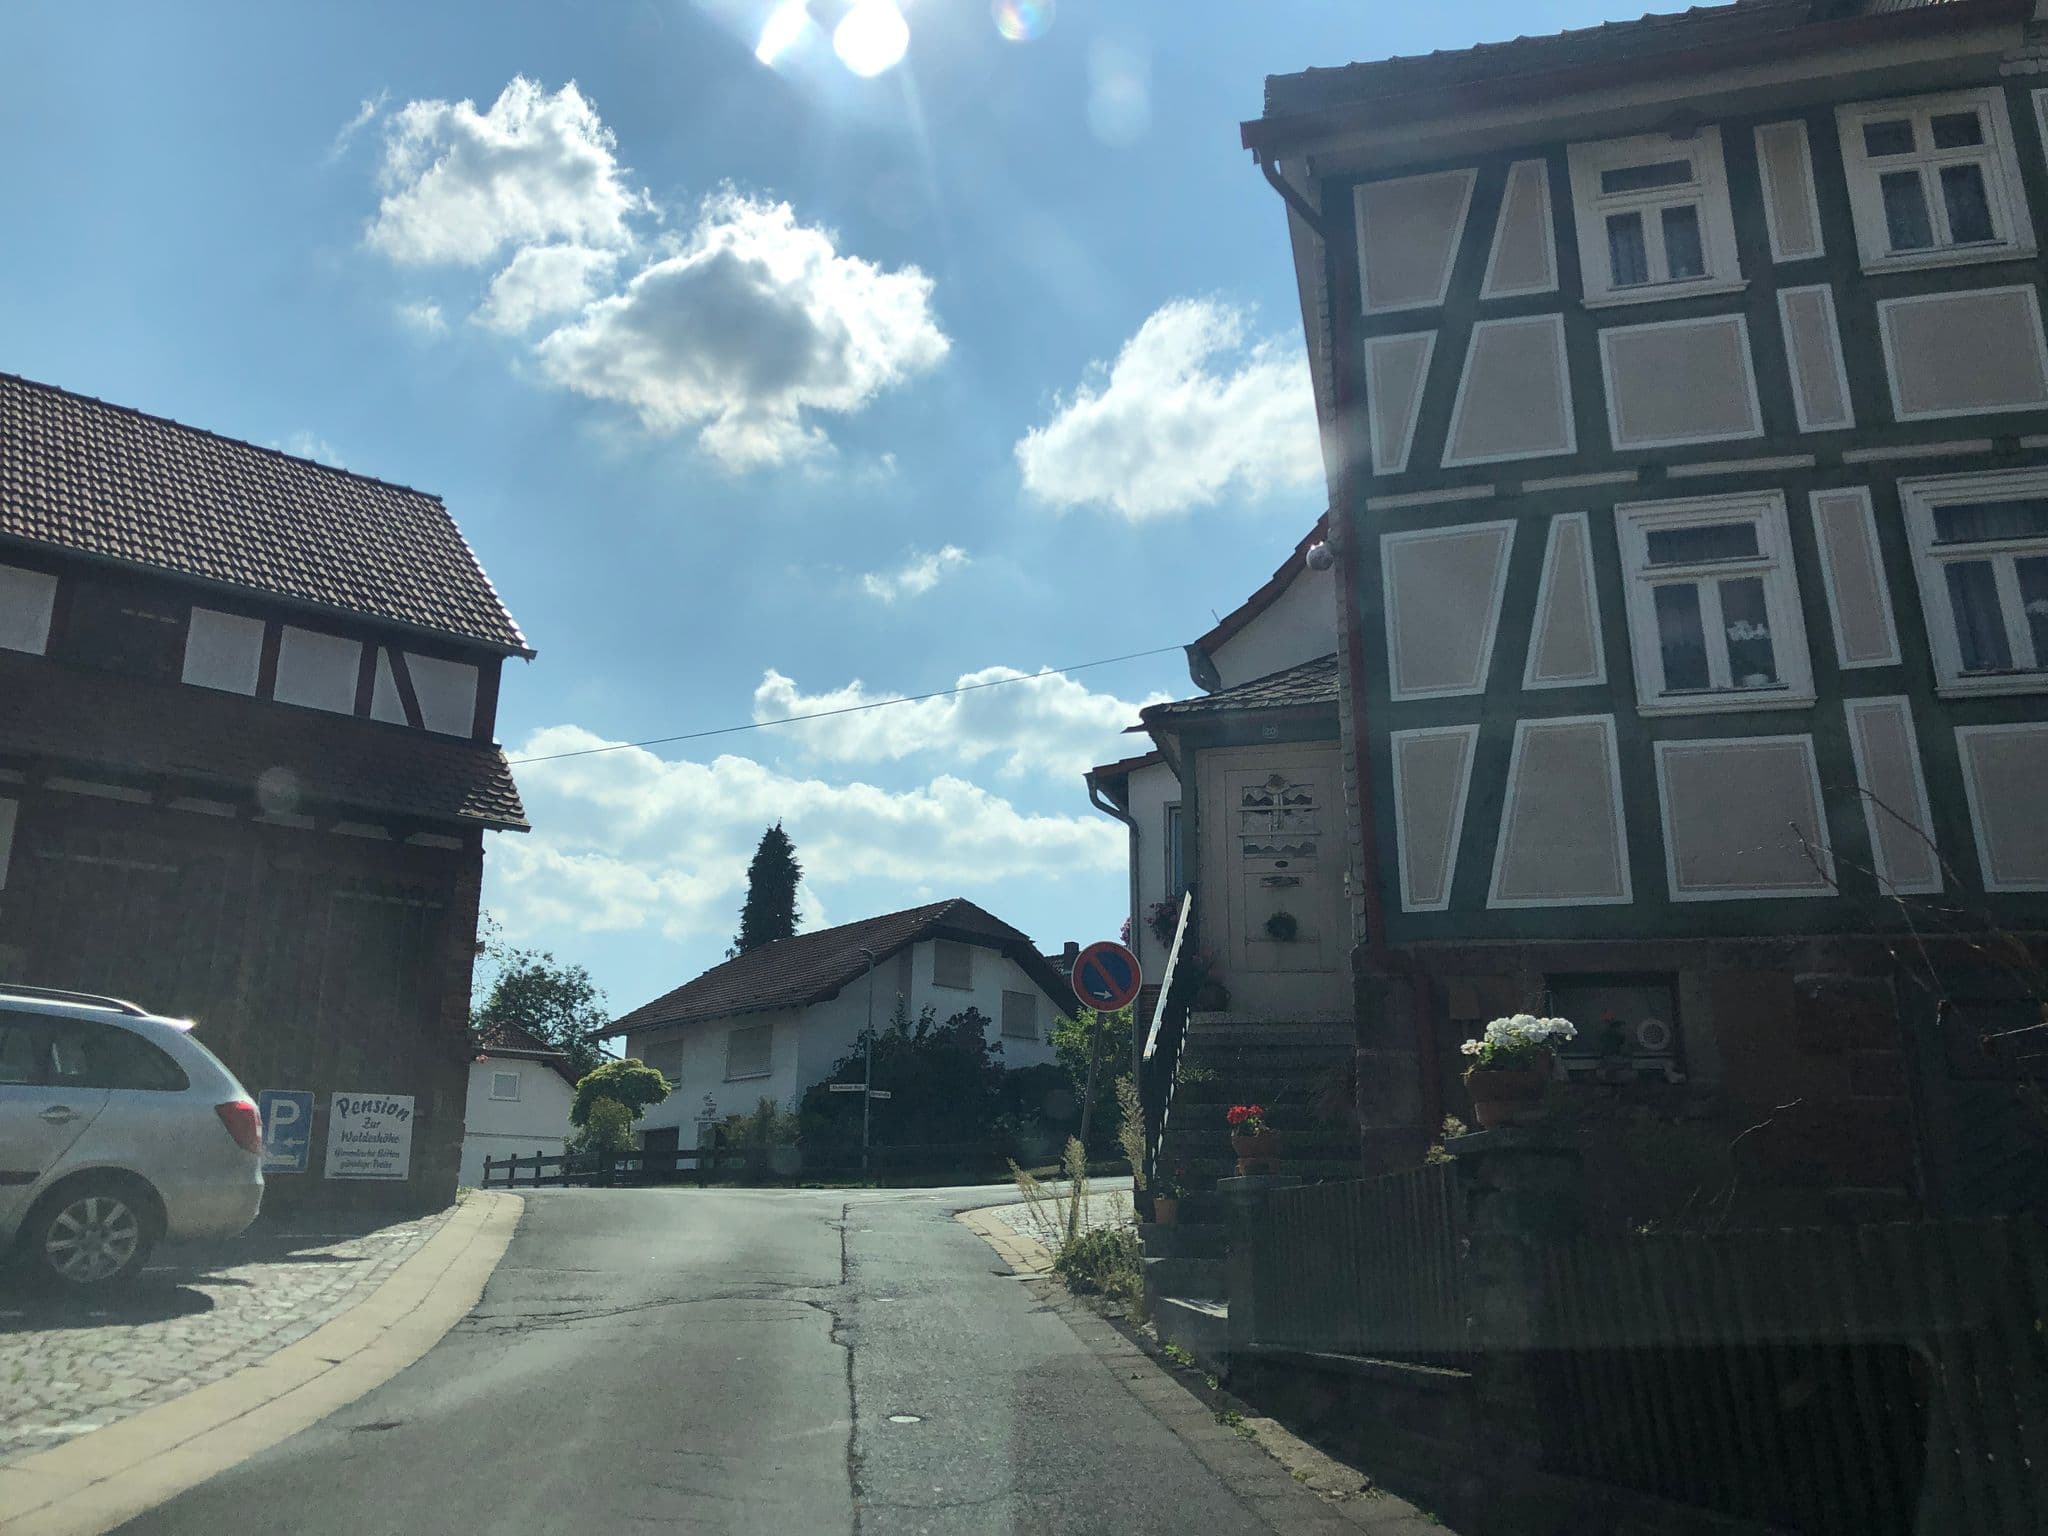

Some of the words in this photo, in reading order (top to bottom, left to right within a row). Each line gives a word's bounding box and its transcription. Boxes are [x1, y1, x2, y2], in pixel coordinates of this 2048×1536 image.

[267, 1099, 301, 1143] P
[336, 1096, 410, 1121] Pension
[362, 1116, 381, 1129] Zur
